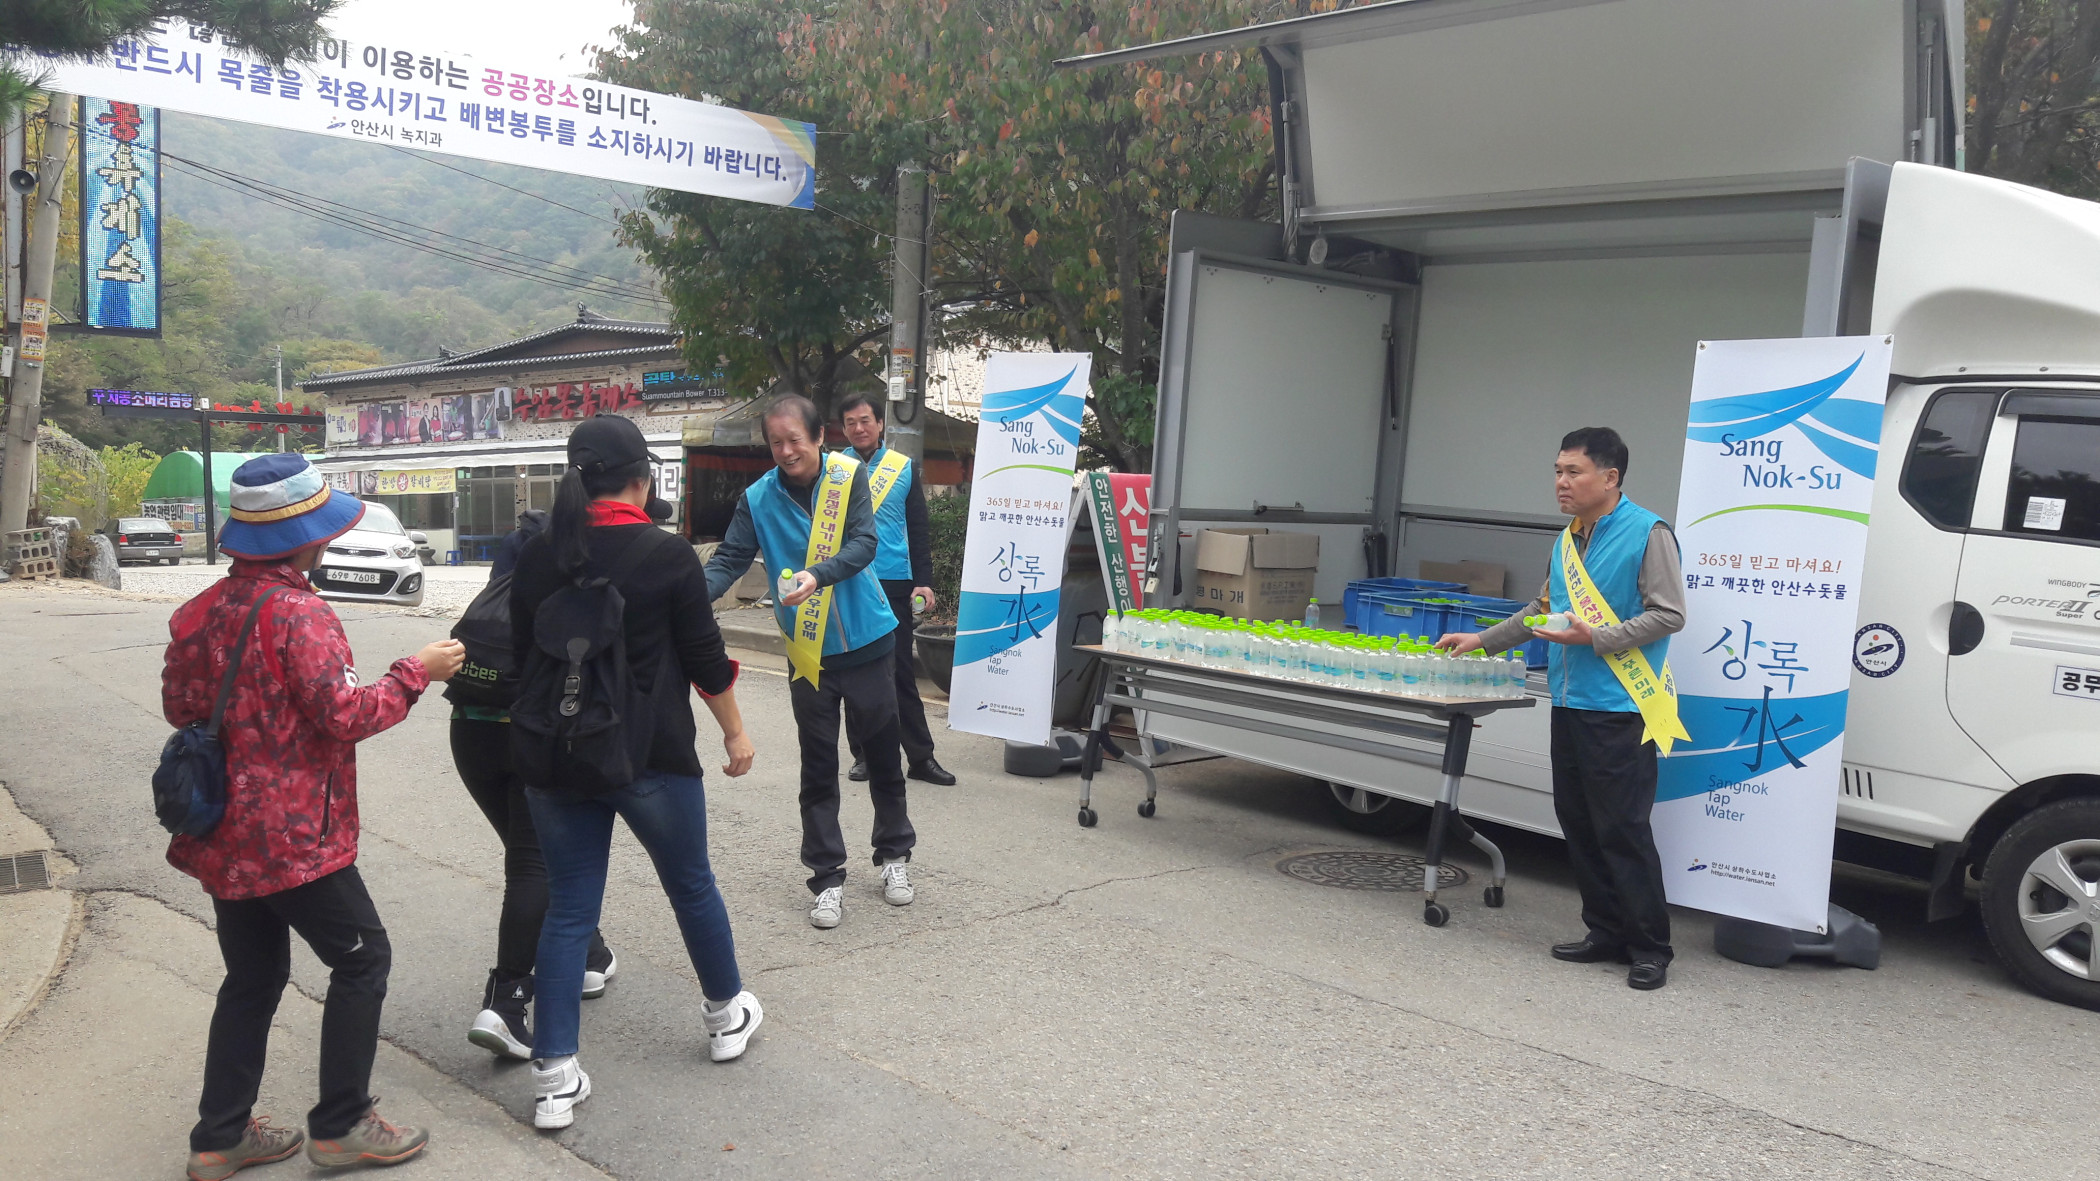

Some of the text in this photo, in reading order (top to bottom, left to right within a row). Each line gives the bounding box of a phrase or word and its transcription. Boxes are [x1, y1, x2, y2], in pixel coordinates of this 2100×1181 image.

[362, 44, 470, 89] 이용하는
[481, 68, 657, 125] 공공장소입니다.
[112, 38, 202, 84] 반드시
[217, 58, 303, 100] 목줄을
[317, 76, 447, 122] 착용시키고
[459, 102, 577, 146] 배변봉투를
[587, 127, 694, 167] 소지하시기
[703, 146, 788, 182] 바랍니다.
[351, 118, 443, 147] 안산시 녹지과
[999, 415, 1034, 437] Sang
[1011, 437, 1065, 456] Nok-Su
[1719, 433, 1784, 463] Sang
[1742, 464, 1842, 490] Nok-Su
[986, 497, 1064, 511] 365일 믿고 마셔요!
[1095, 478, 1118, 543] 안전한
[979, 511, 1065, 528] 맑고 깨끗한 안산수돗물
[988, 541, 1045, 590] 상록
[1698, 553, 1842, 574] 365일 믿고 마셔요!
[353, 573, 376, 583] 7608
[1686, 574, 1848, 600] 맑고 깨끗한 안산수돗물
[1991, 594, 2072, 609] PORTER
[999, 585, 1042, 642] 水
[2055, 611, 2084, 619] Super
[988, 655, 1002, 666] Tap
[989, 644, 1022, 660] Sangnok
[1702, 619, 1809, 695] 상록
[987, 665, 1009, 676] Water
[1723, 685, 1808, 773] 水
[1708, 774, 1769, 796] Sangnok
[1707, 789, 1731, 807] Tap
[1705, 804, 1745, 823] Water
[1711, 861, 1731, 871] 안산시
